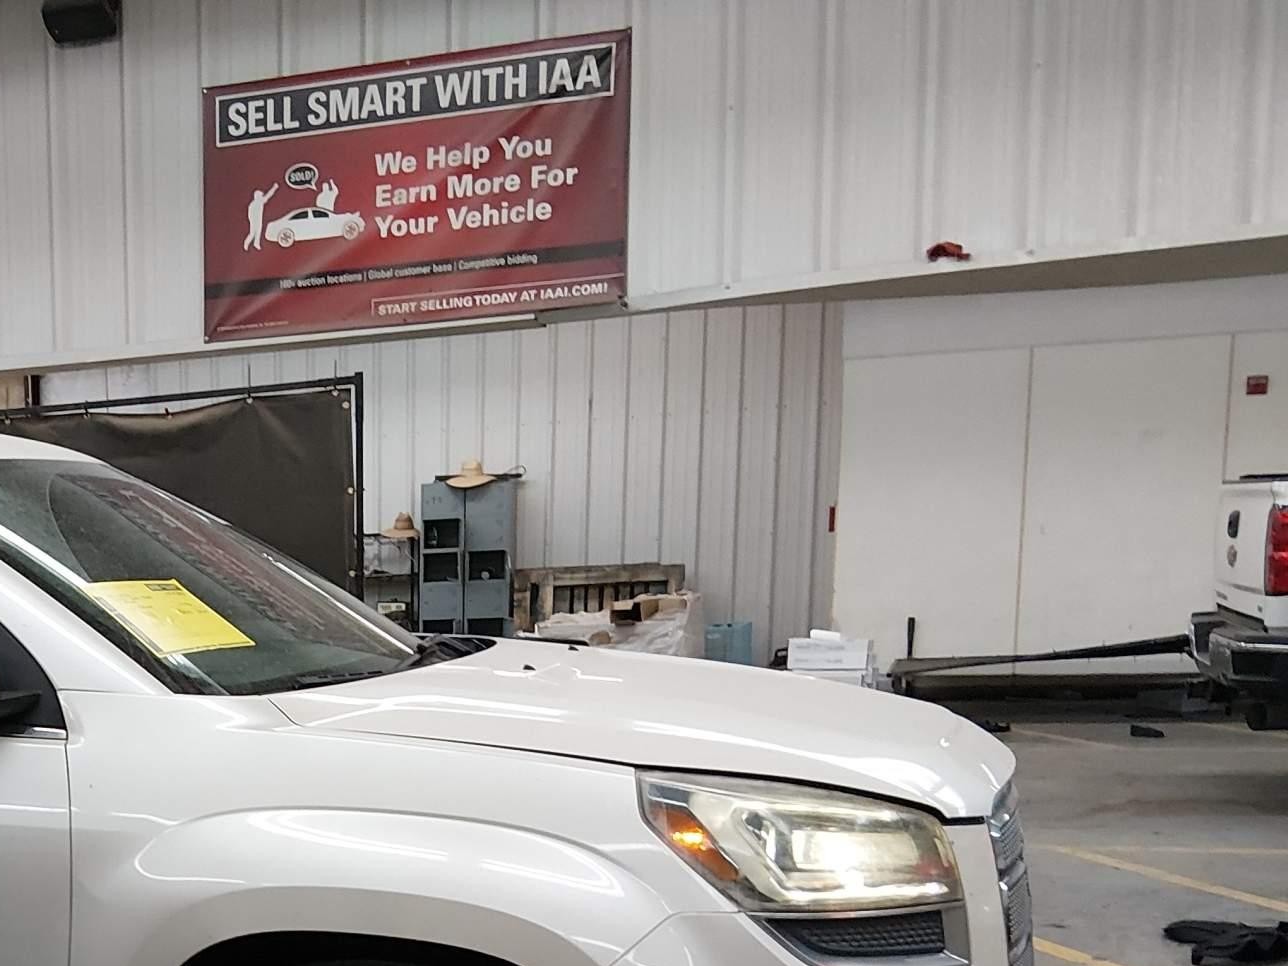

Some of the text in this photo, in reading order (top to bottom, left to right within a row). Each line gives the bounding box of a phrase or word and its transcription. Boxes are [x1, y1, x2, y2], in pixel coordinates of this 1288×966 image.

[227, 54, 602, 138] SELL SMART WITH IAA
[375, 135, 552, 176] We Help You
[375, 164, 578, 208] Earn More For
[375, 198, 552, 239] Your Vehicle
[297, 276, 326, 288] auction
[327, 272, 362, 285] locations
[367, 268, 393, 280] Global
[394, 264, 431, 278] customer
[432, 263, 452, 273] base
[458, 257, 506, 271] Competitive
[506, 254, 538, 265] bidding
[377, 281, 609, 316] START SELLING TODAY AT IAAI.COM!
